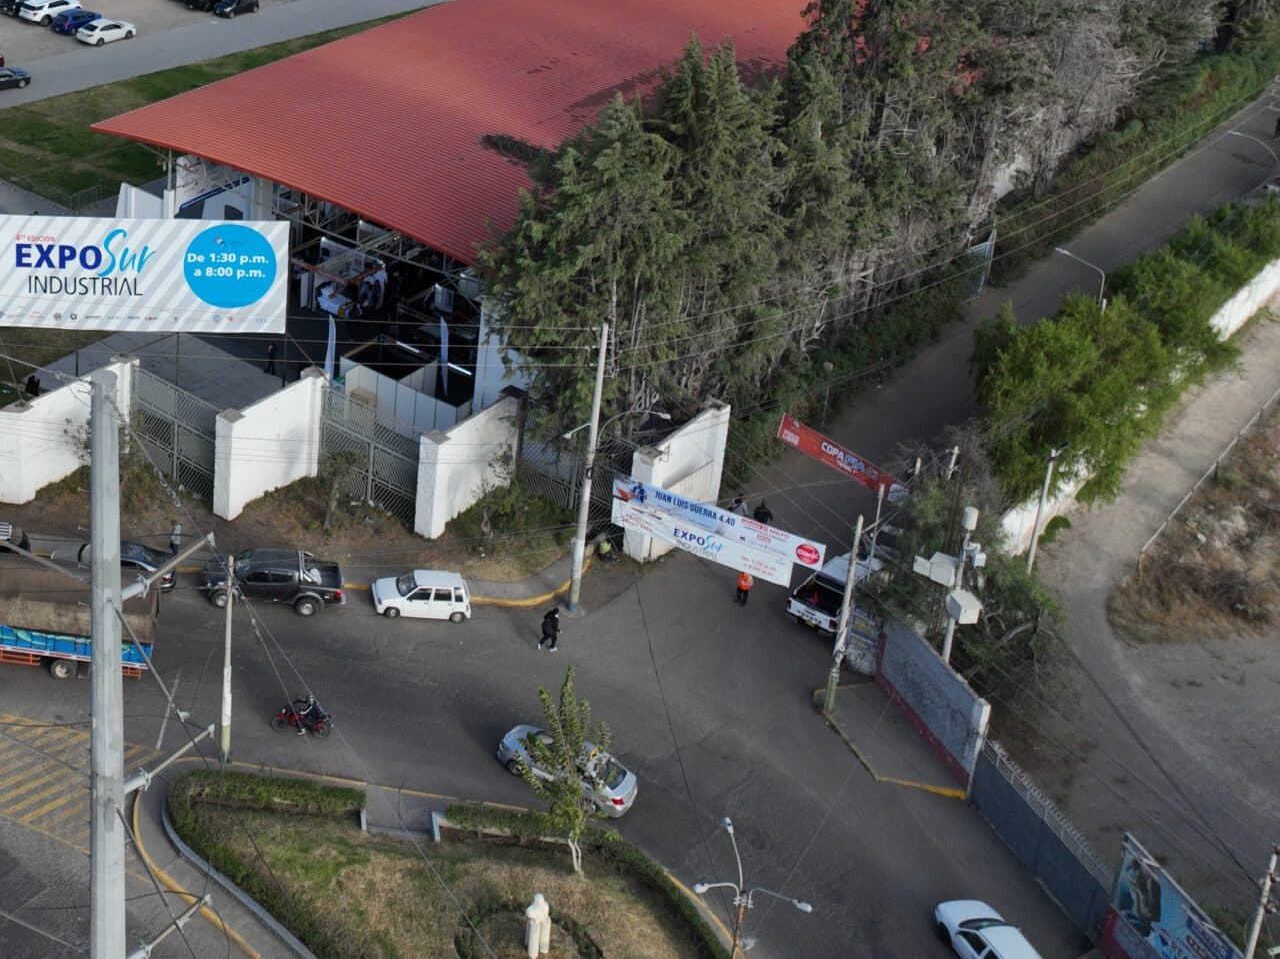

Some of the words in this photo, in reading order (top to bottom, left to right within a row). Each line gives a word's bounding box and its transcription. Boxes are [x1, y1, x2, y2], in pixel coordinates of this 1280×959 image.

[15, 244, 103, 271] EXPO
[186, 253, 205, 264] De
[209, 253, 236, 264] 1:30
[239, 254, 270, 266] p.m.
[194, 269, 202, 277] a
[205, 267, 233, 278] 8:00
[236, 269, 267, 280] p.m.
[28, 275, 143, 297] INDUSTRIAL
[821, 442, 845, 462] COPA
[655, 491, 672, 504] JUAN
[673, 496, 689, 510] LUIS
[689, 502, 717, 520] GUERRA
[673, 528, 706, 546] EXPO
